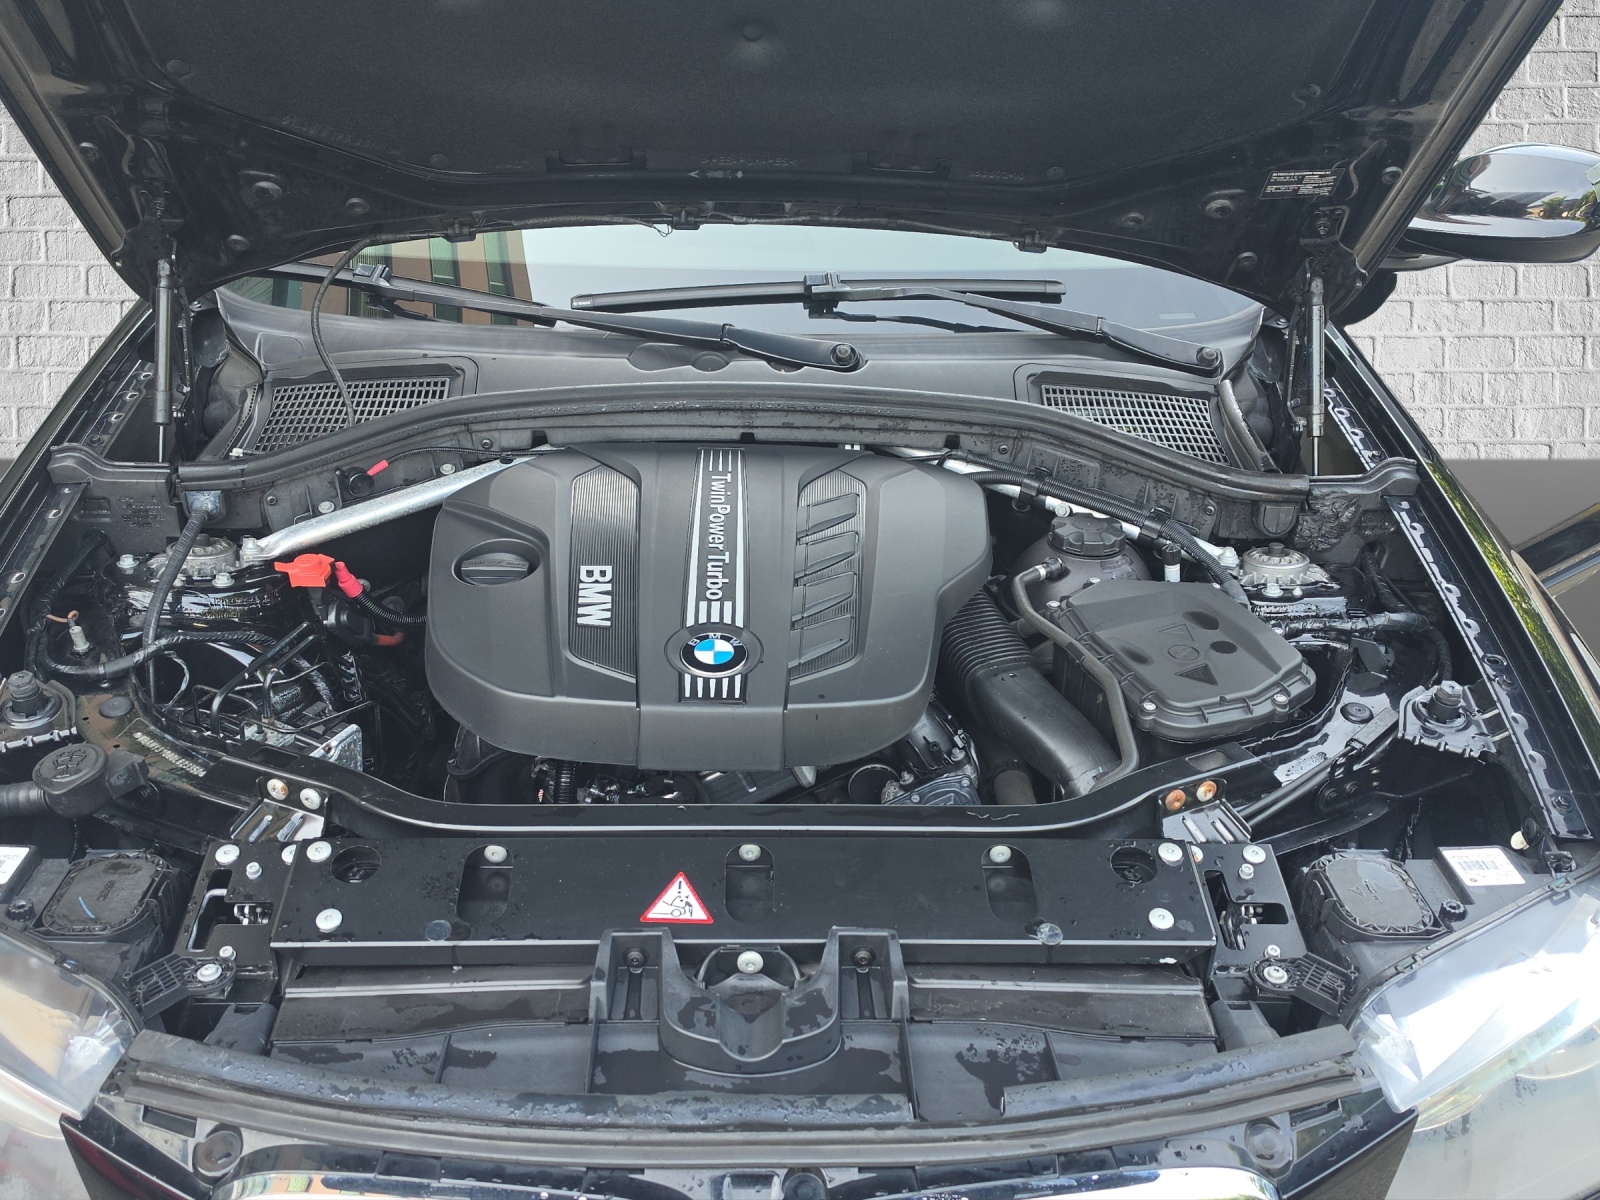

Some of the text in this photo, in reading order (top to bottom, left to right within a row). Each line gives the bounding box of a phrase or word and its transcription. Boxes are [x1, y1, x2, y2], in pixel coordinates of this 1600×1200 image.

[705, 473, 732, 600] TwinPower Turbo
[577, 565, 613, 627] BMW
[688, 633, 743, 647] BMW
